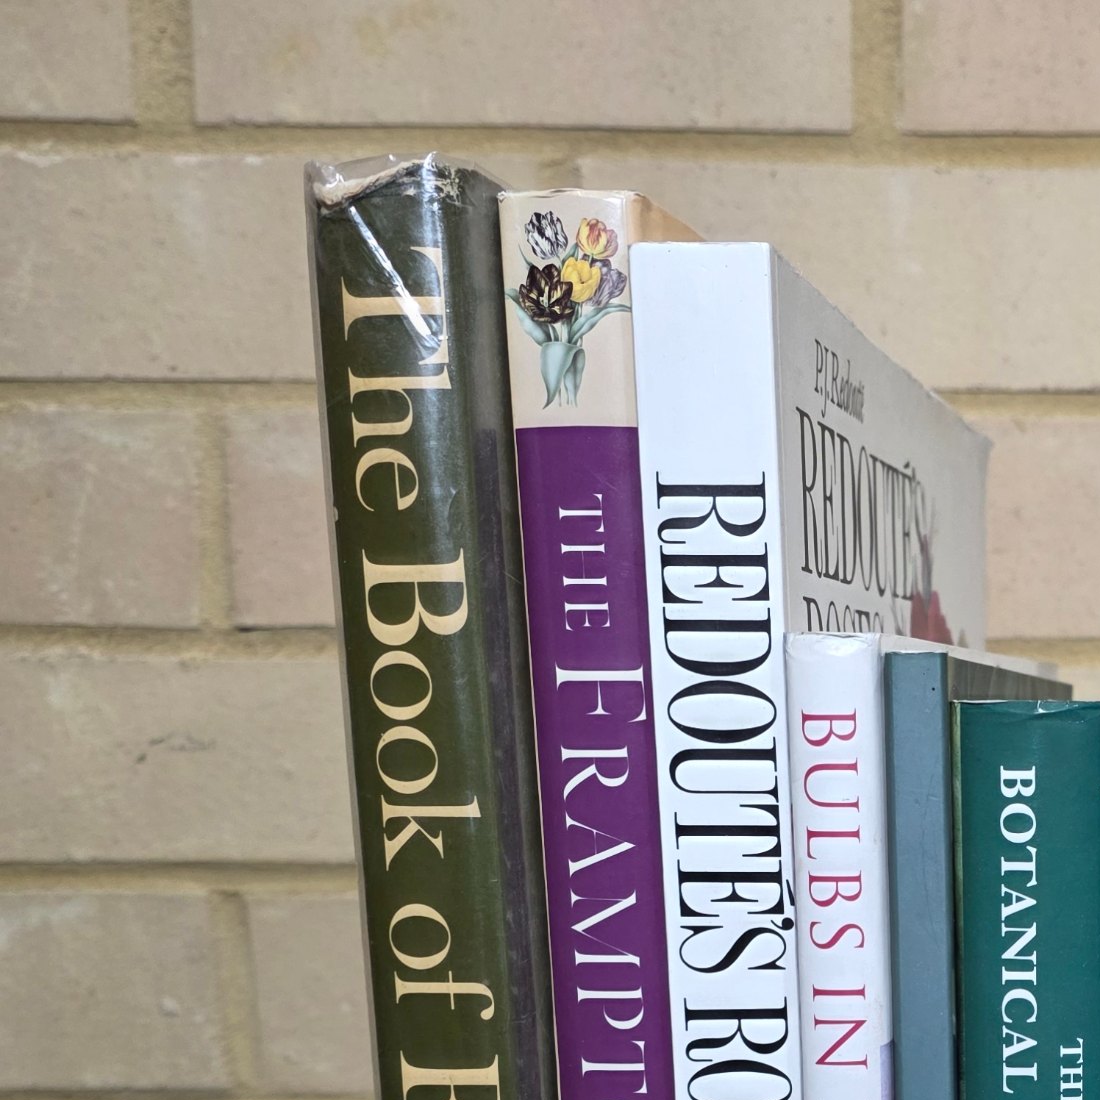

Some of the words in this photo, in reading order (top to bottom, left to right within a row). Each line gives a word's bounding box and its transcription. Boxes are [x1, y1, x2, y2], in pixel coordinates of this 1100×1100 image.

[341, 245, 452, 512] The
[558, 493, 611, 631] THE
[362, 548, 482, 872] Book
[800, 708, 865, 950] BULBS
[389, 903, 495, 1021] of
[812, 983, 868, 1069] IN
[1000, 765, 1038, 1094] BOTANICAL
